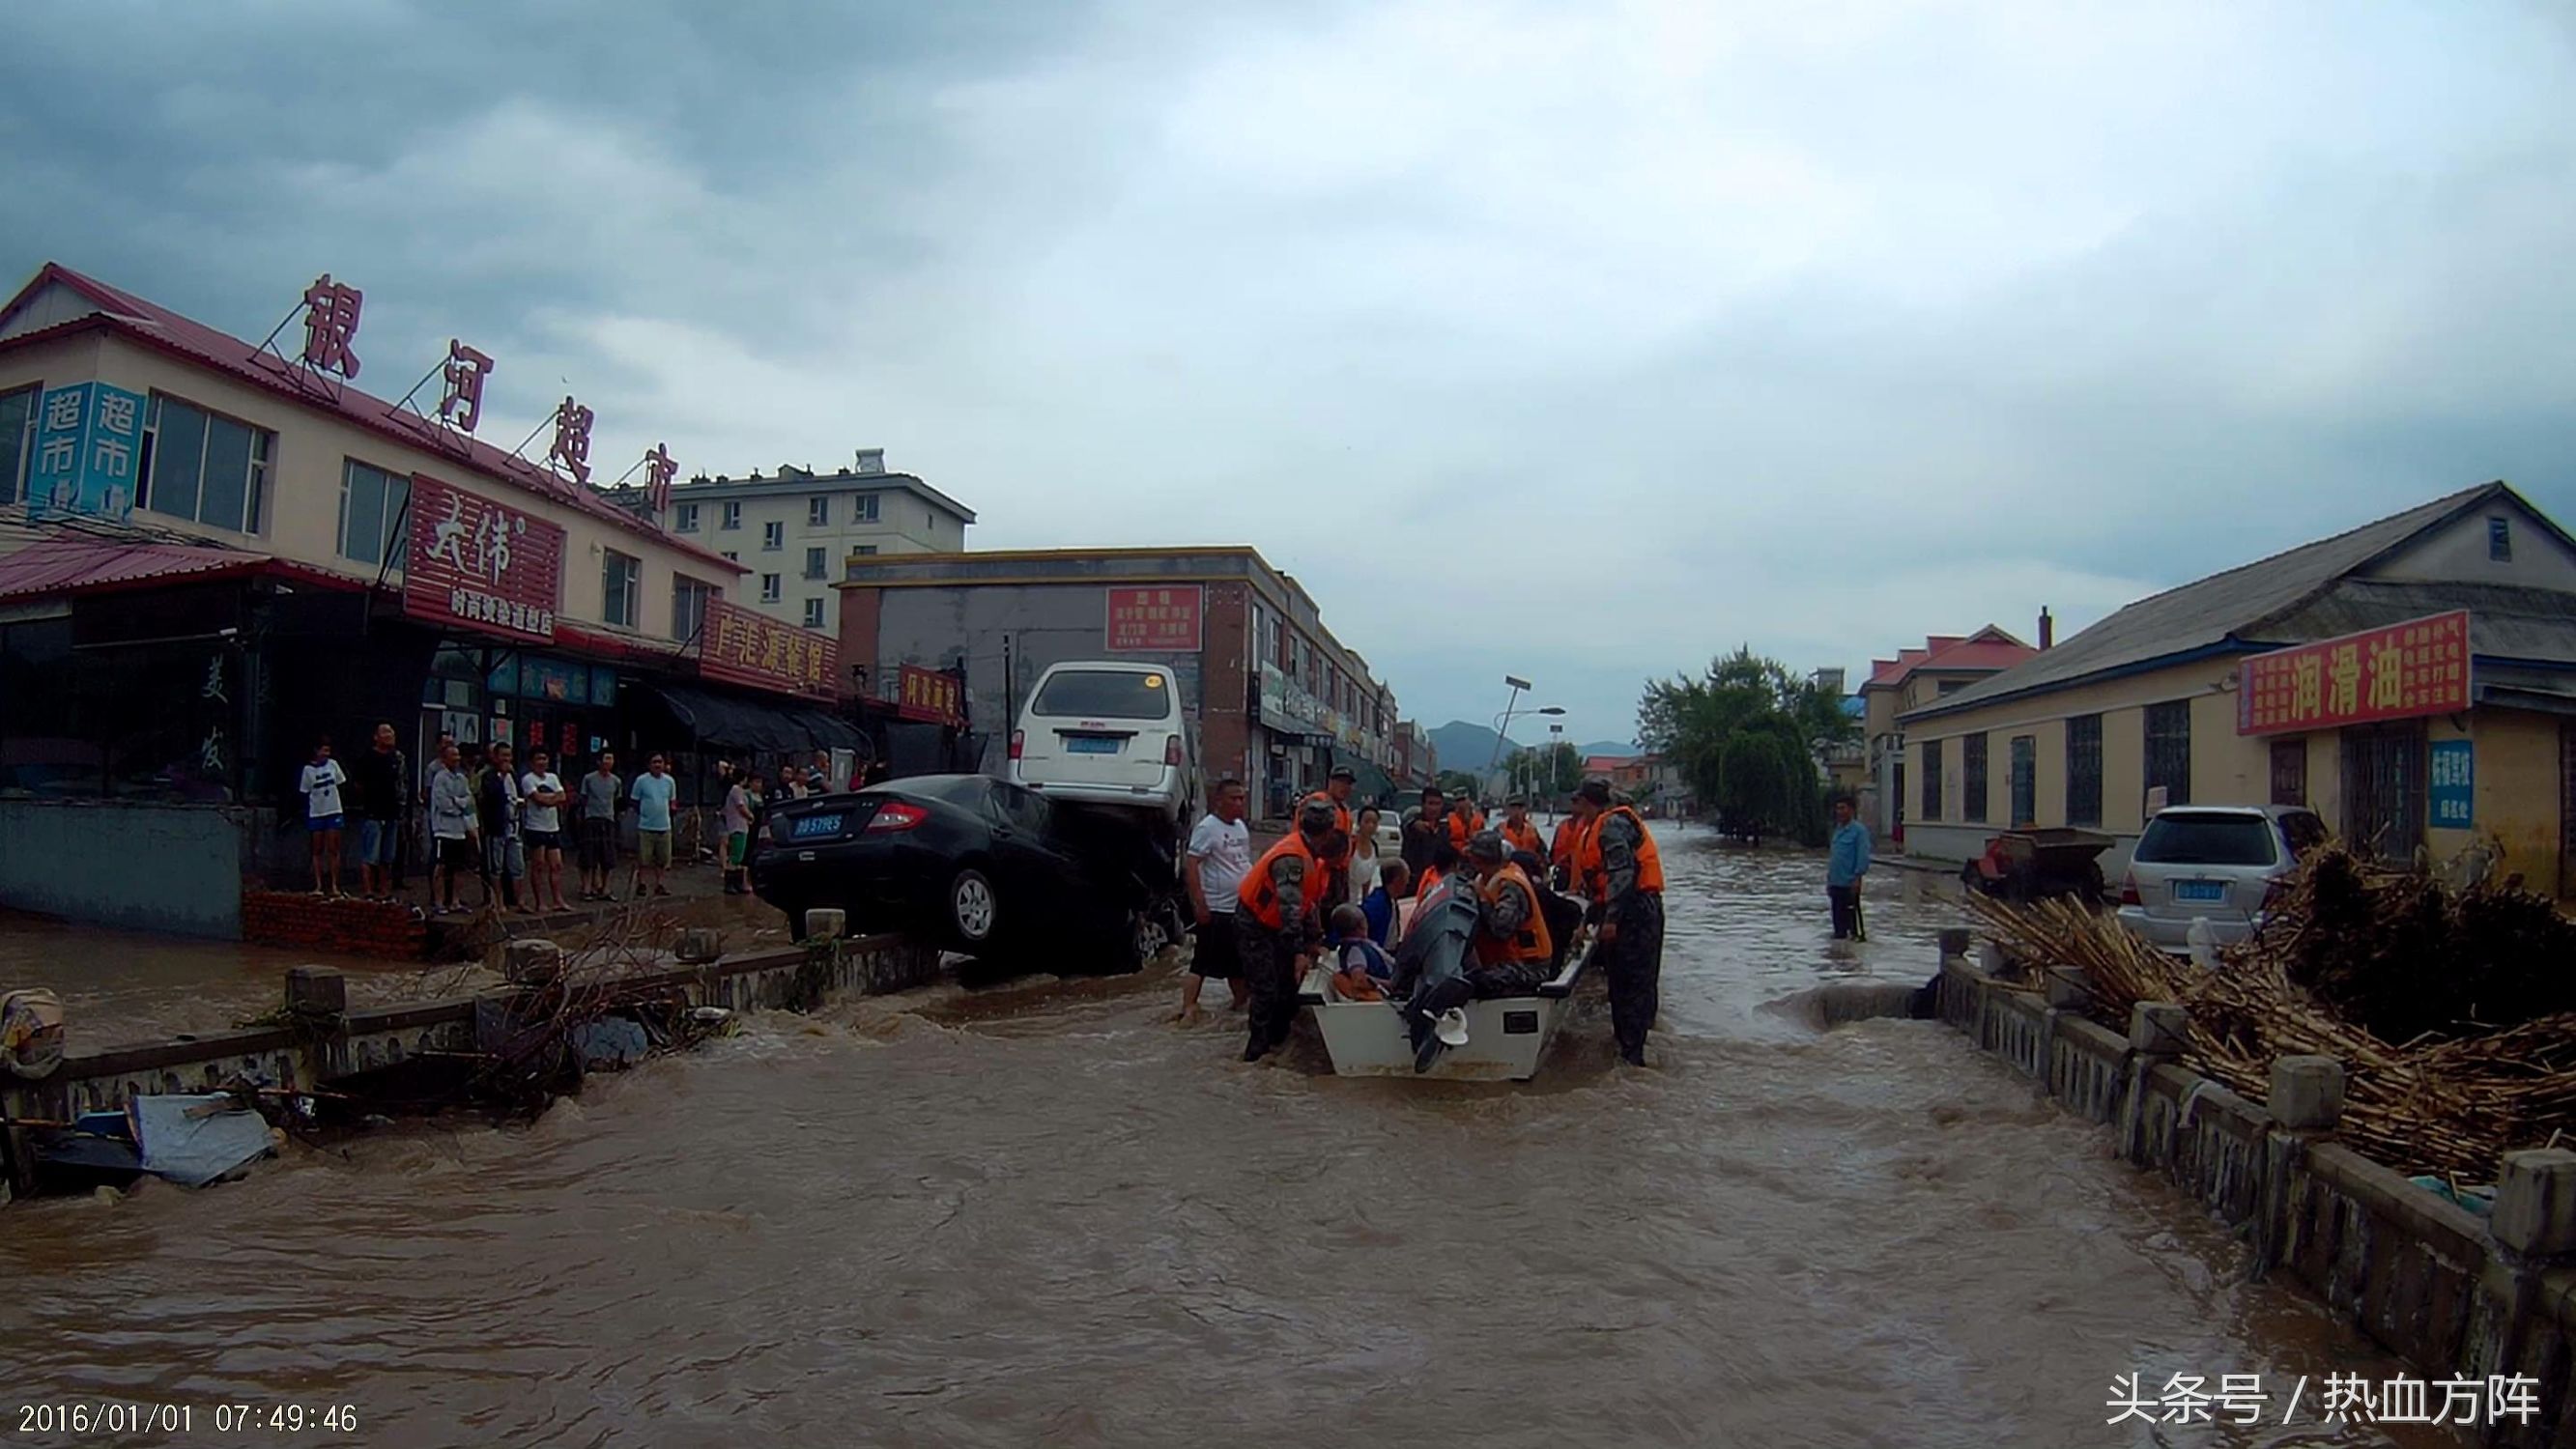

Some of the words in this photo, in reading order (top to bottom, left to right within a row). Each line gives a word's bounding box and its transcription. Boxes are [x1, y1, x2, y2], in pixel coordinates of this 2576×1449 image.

[41, 390, 82, 474] 超市
[94, 392, 135, 476] 超市
[304, 274, 678, 512] 银河超市
[2292, 634, 2402, 721] 润滑油
